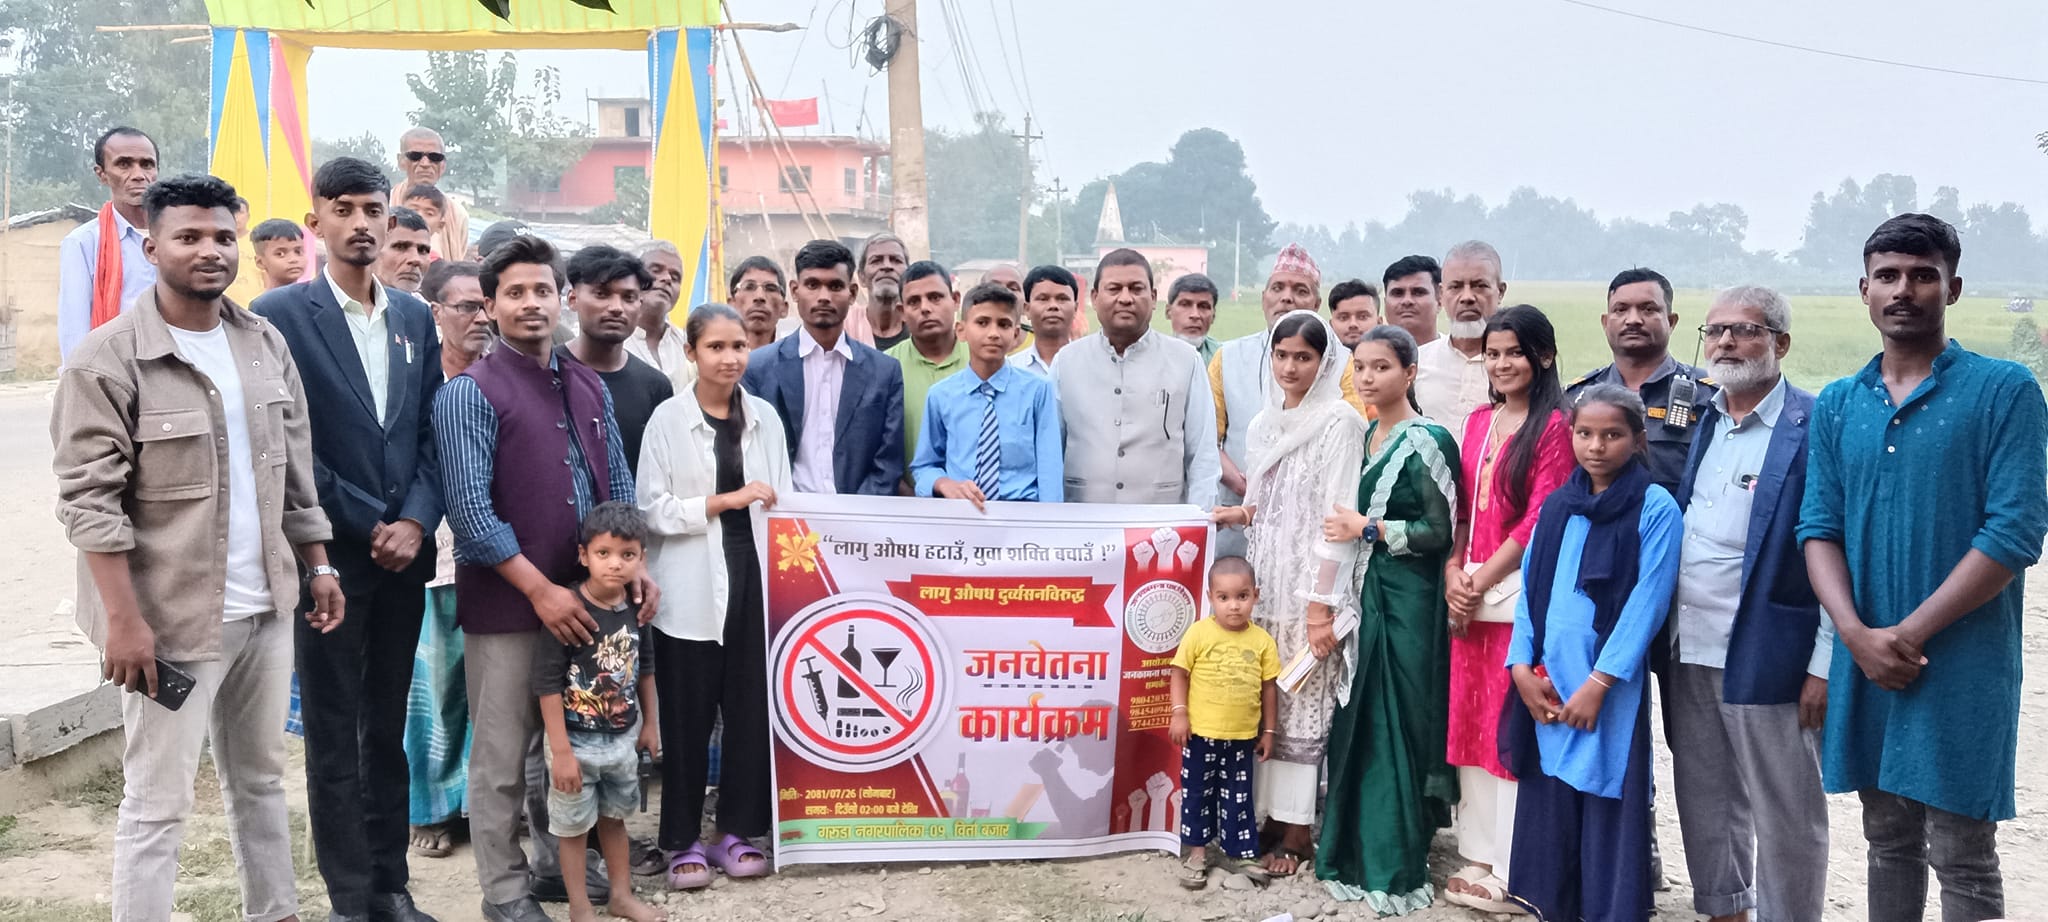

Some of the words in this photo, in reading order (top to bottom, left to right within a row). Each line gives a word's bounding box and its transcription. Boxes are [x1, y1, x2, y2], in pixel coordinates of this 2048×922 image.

[874, 537, 920, 559] औषध
[924, 539, 968, 565] हटाउँ,
[973, 546, 1002, 566] युवा
[1006, 543, 1050, 561] शक्ति
[1053, 542, 1094, 561] बचाउँ
[919, 586, 951, 604] लागु
[954, 583, 995, 600] औषध
[963, 640, 1110, 680] जनचेतना
[957, 692, 1113, 744] कार्यक्रम
[805, 789, 857, 799] 2081/07/26
